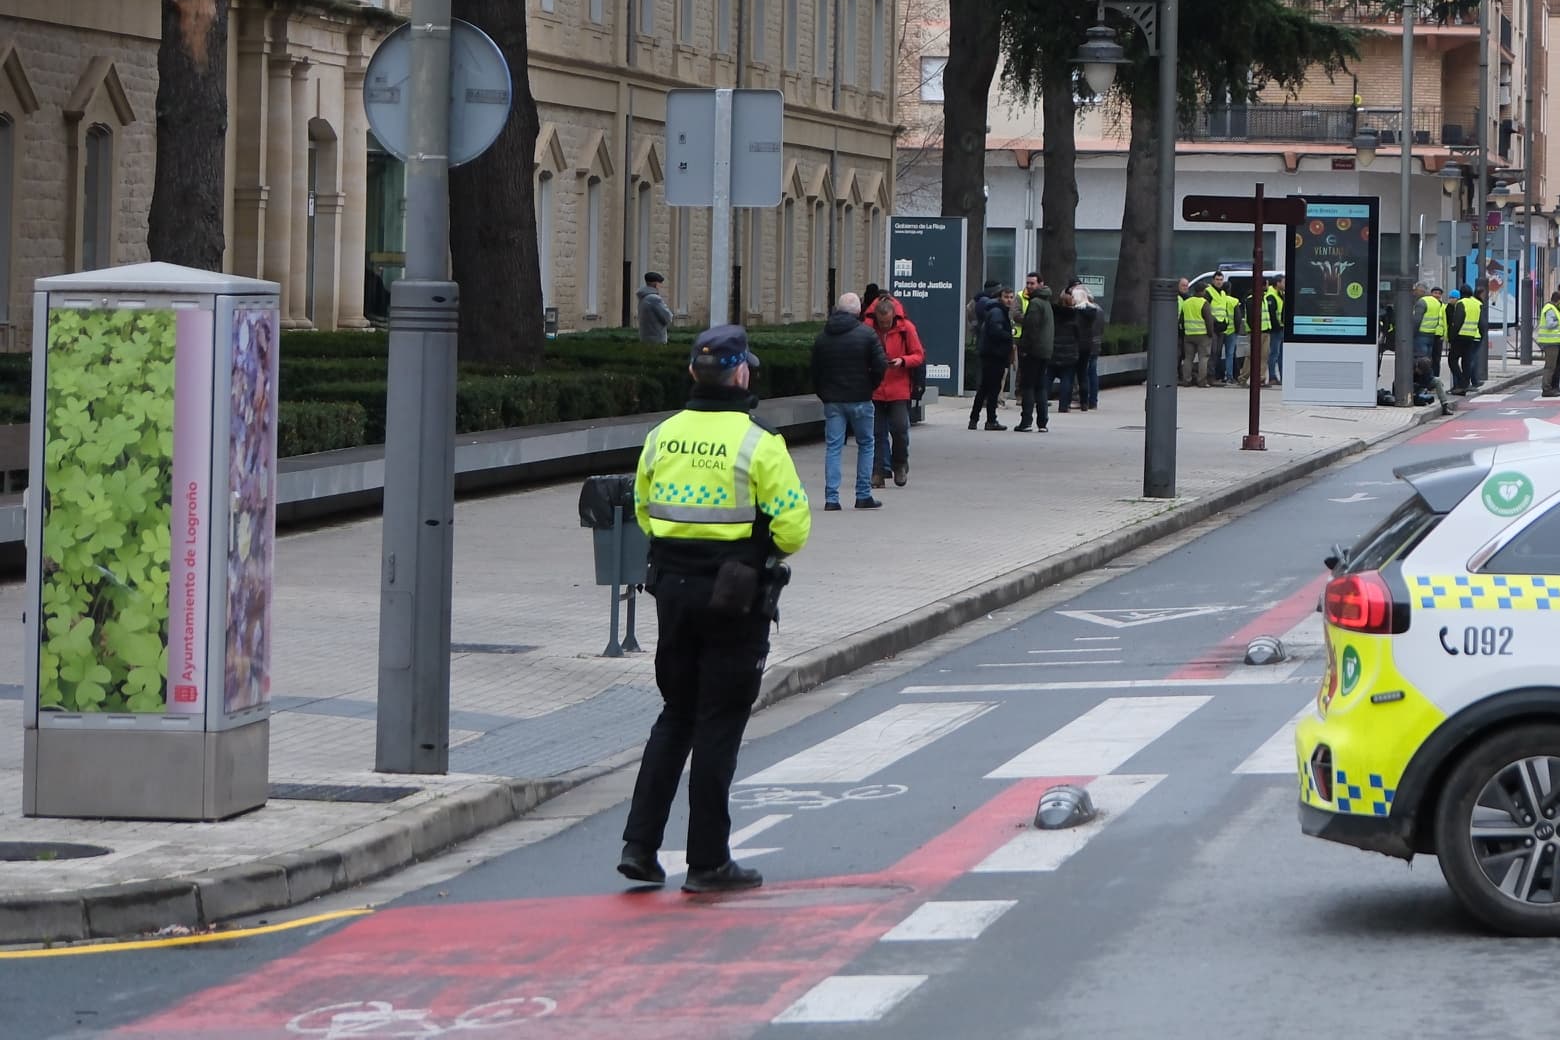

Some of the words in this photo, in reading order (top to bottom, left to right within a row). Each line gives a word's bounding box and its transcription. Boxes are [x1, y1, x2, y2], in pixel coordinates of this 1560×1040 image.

[894, 280, 917, 289] Palacio
[918, 281, 927, 289] de
[927, 281, 953, 289] Justicia
[894, 290, 902, 298] de
[903, 290, 911, 298] La
[660, 440, 728, 457] POLICIA
[691, 459, 727, 471] LOCAL
[185, 481, 200, 545] Logroño
[184, 548, 196, 571] de
[182, 572, 199, 681] Ayuntamiento
[1463, 625, 1515, 656] 092
